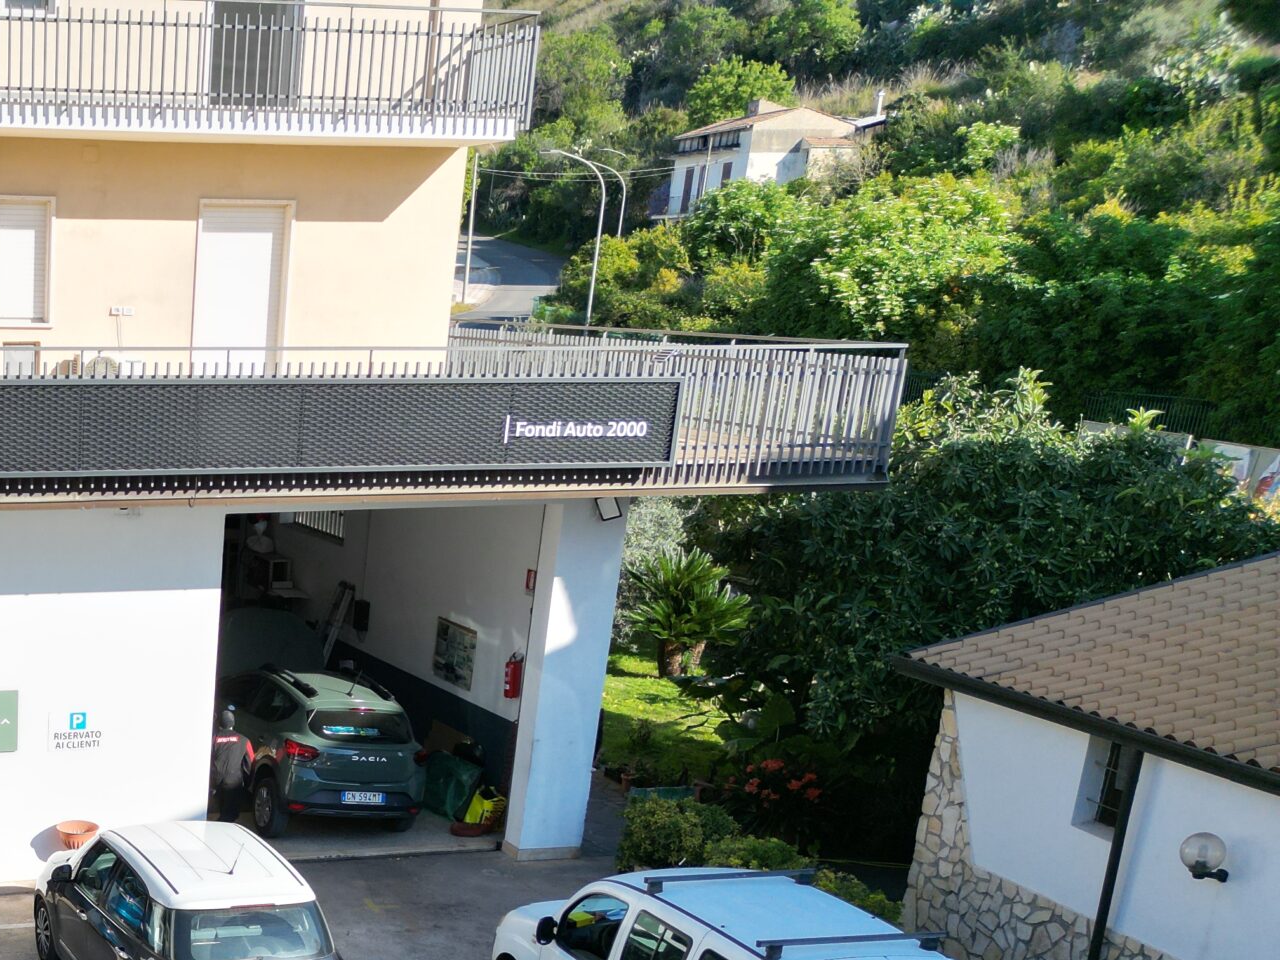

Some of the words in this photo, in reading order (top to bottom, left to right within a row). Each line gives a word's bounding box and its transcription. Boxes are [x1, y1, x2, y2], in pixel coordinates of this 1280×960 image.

[515, 421, 562, 437] Fondi
[564, 421, 603, 437] Auto
[607, 421, 648, 437] 2000
[53, 730, 102, 741] RISERVATO
[55, 741, 64, 749] AI
[66, 740, 100, 749] CLIENTI
